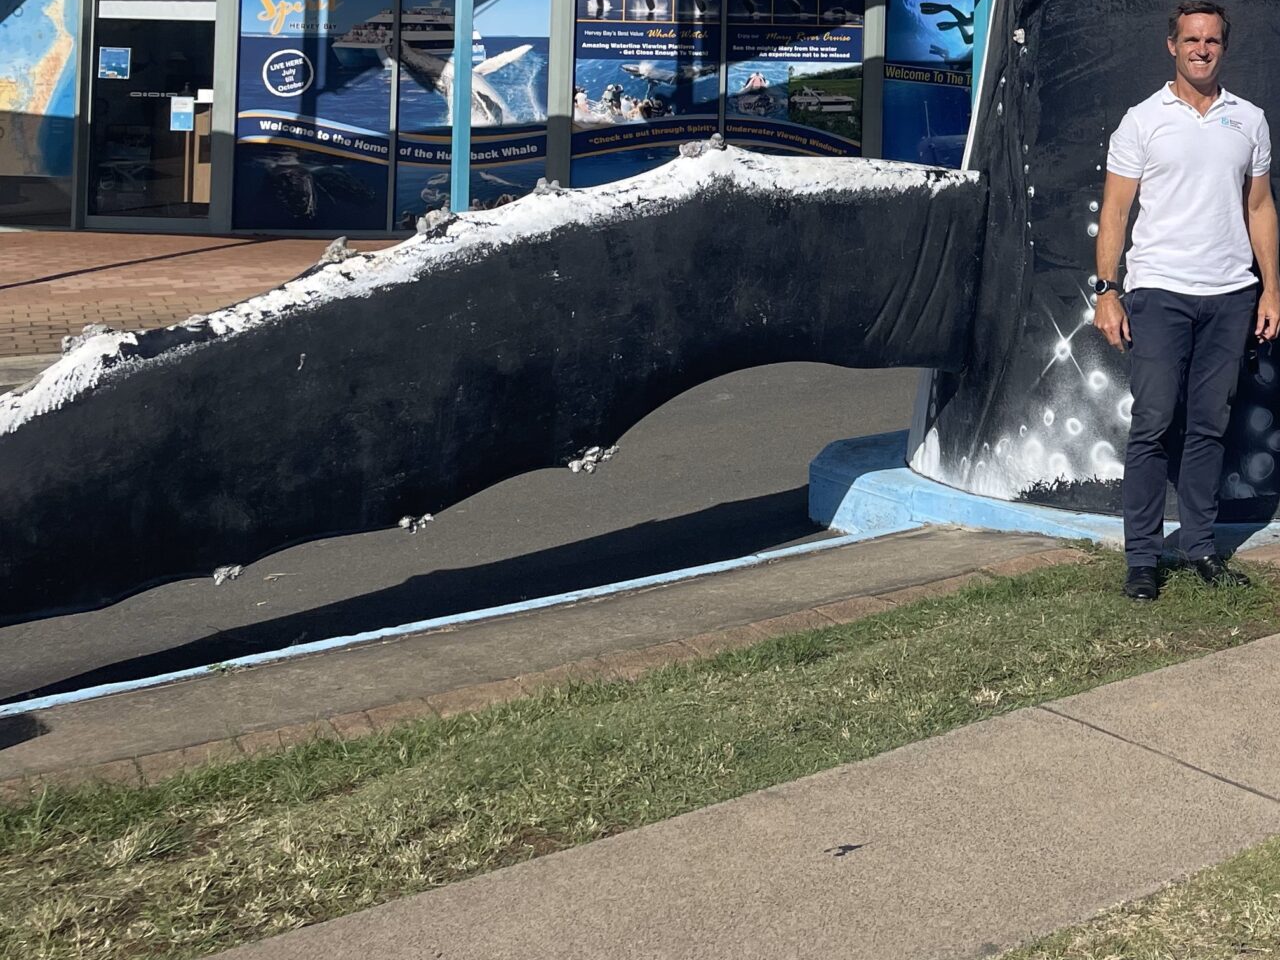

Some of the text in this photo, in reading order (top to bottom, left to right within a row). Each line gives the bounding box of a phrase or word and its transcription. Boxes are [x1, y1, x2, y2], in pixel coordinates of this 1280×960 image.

[581, 42, 610, 50] Amazing
[270, 58, 304, 71] LIVE HERE
[282, 68, 296, 77] July
[885, 65, 930, 81] Welcome
[933, 71, 944, 83] To
[946, 72, 963, 85] The
[278, 82, 304, 91] October
[260, 120, 314, 137] Welcome
[317, 130, 330, 140] to
[332, 134, 351, 146] the
[354, 139, 388, 153] Home
[400, 147, 412, 156] of
[414, 148, 433, 159] the
[502, 144, 538, 157] Whale
